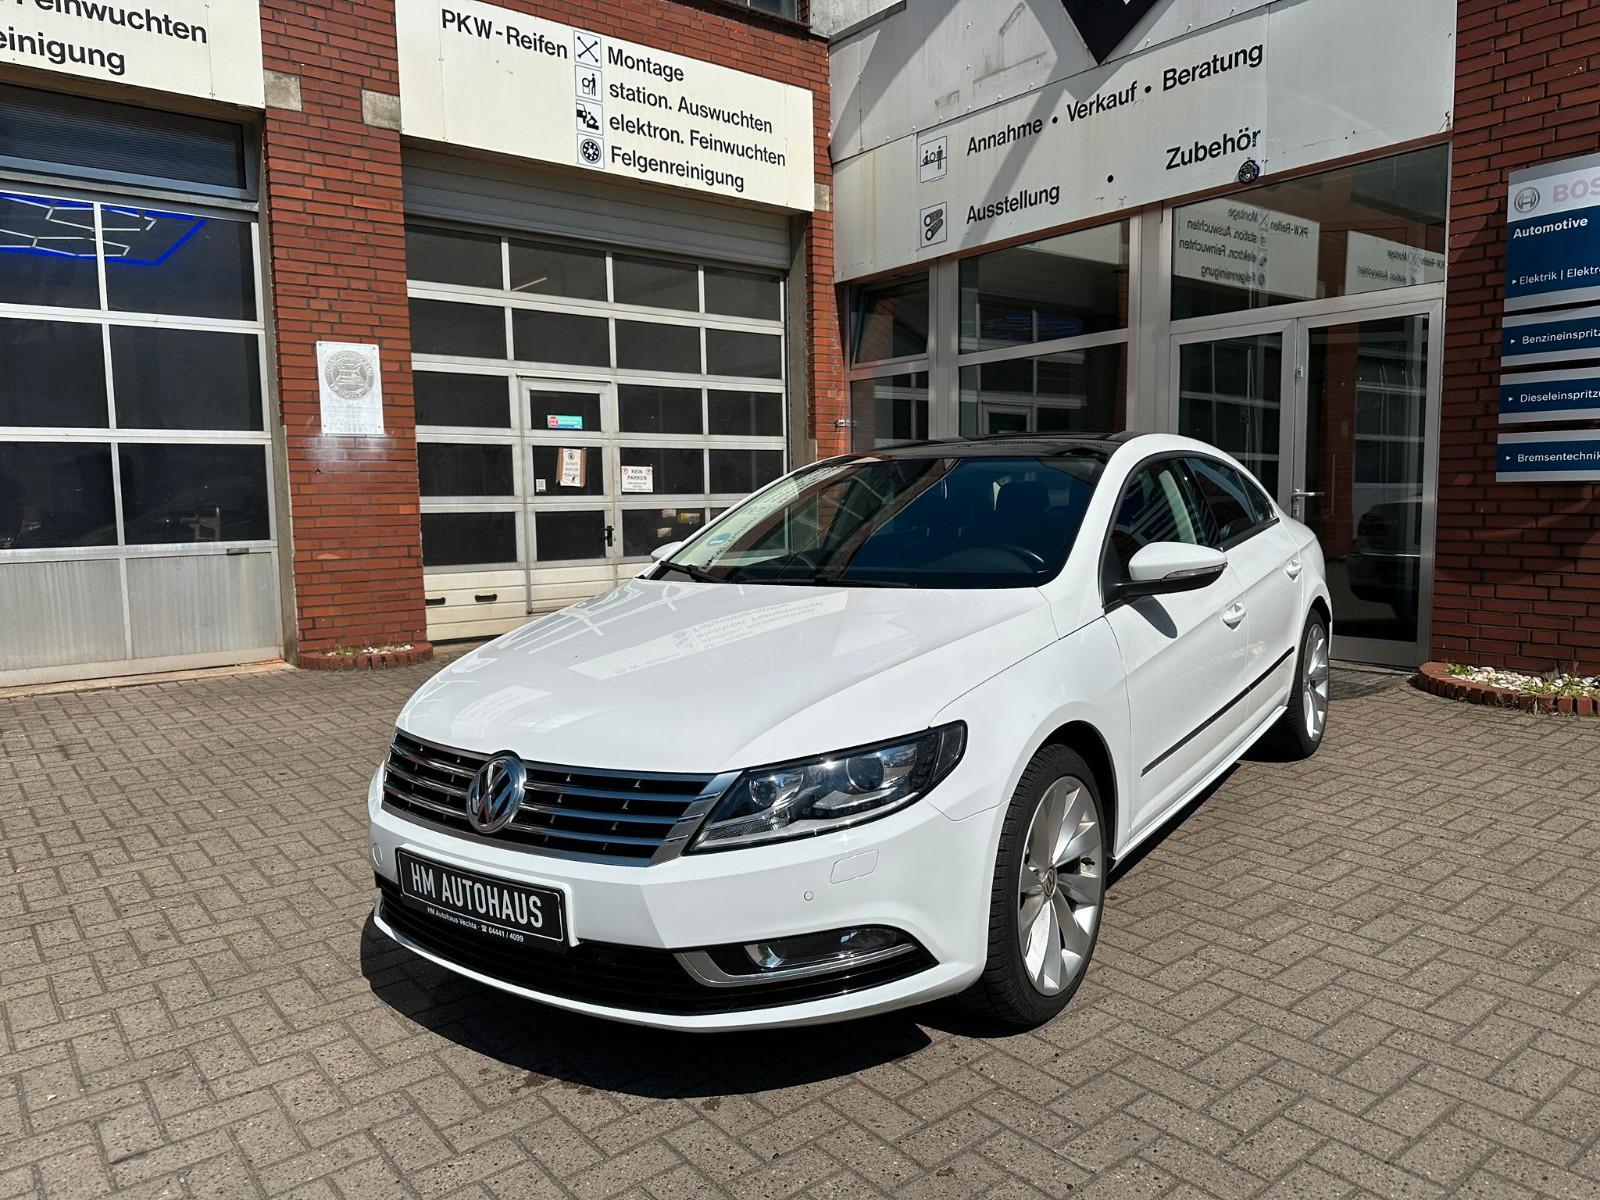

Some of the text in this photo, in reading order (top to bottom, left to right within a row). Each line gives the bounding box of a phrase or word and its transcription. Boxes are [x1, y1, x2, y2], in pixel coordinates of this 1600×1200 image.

[441, 8, 568, 59] PKW-Reifen
[607, 46, 684, 82] Montage
[609, 82, 773, 134] station. Auswuchten
[966, 44, 1264, 156] Annahme Verkauf Beratung
[609, 113, 786, 167] elektron. Feinwuchten
[610, 145, 744, 192] Felgenreinigung
[966, 126, 1262, 224] Ausstellung Zubehör
[1513, 218, 1589, 239] Automotive
[1519, 271, 1557, 285] Elektrik
[1567, 266, 1600, 278] Elektr
[1520, 389, 1600, 403] Dieseleinspritz
[410, 861, 543, 928] HM AUTOHAUS
[435, 908, 459, 924] Autohaus
[459, 918, 477, 930] Vechta
